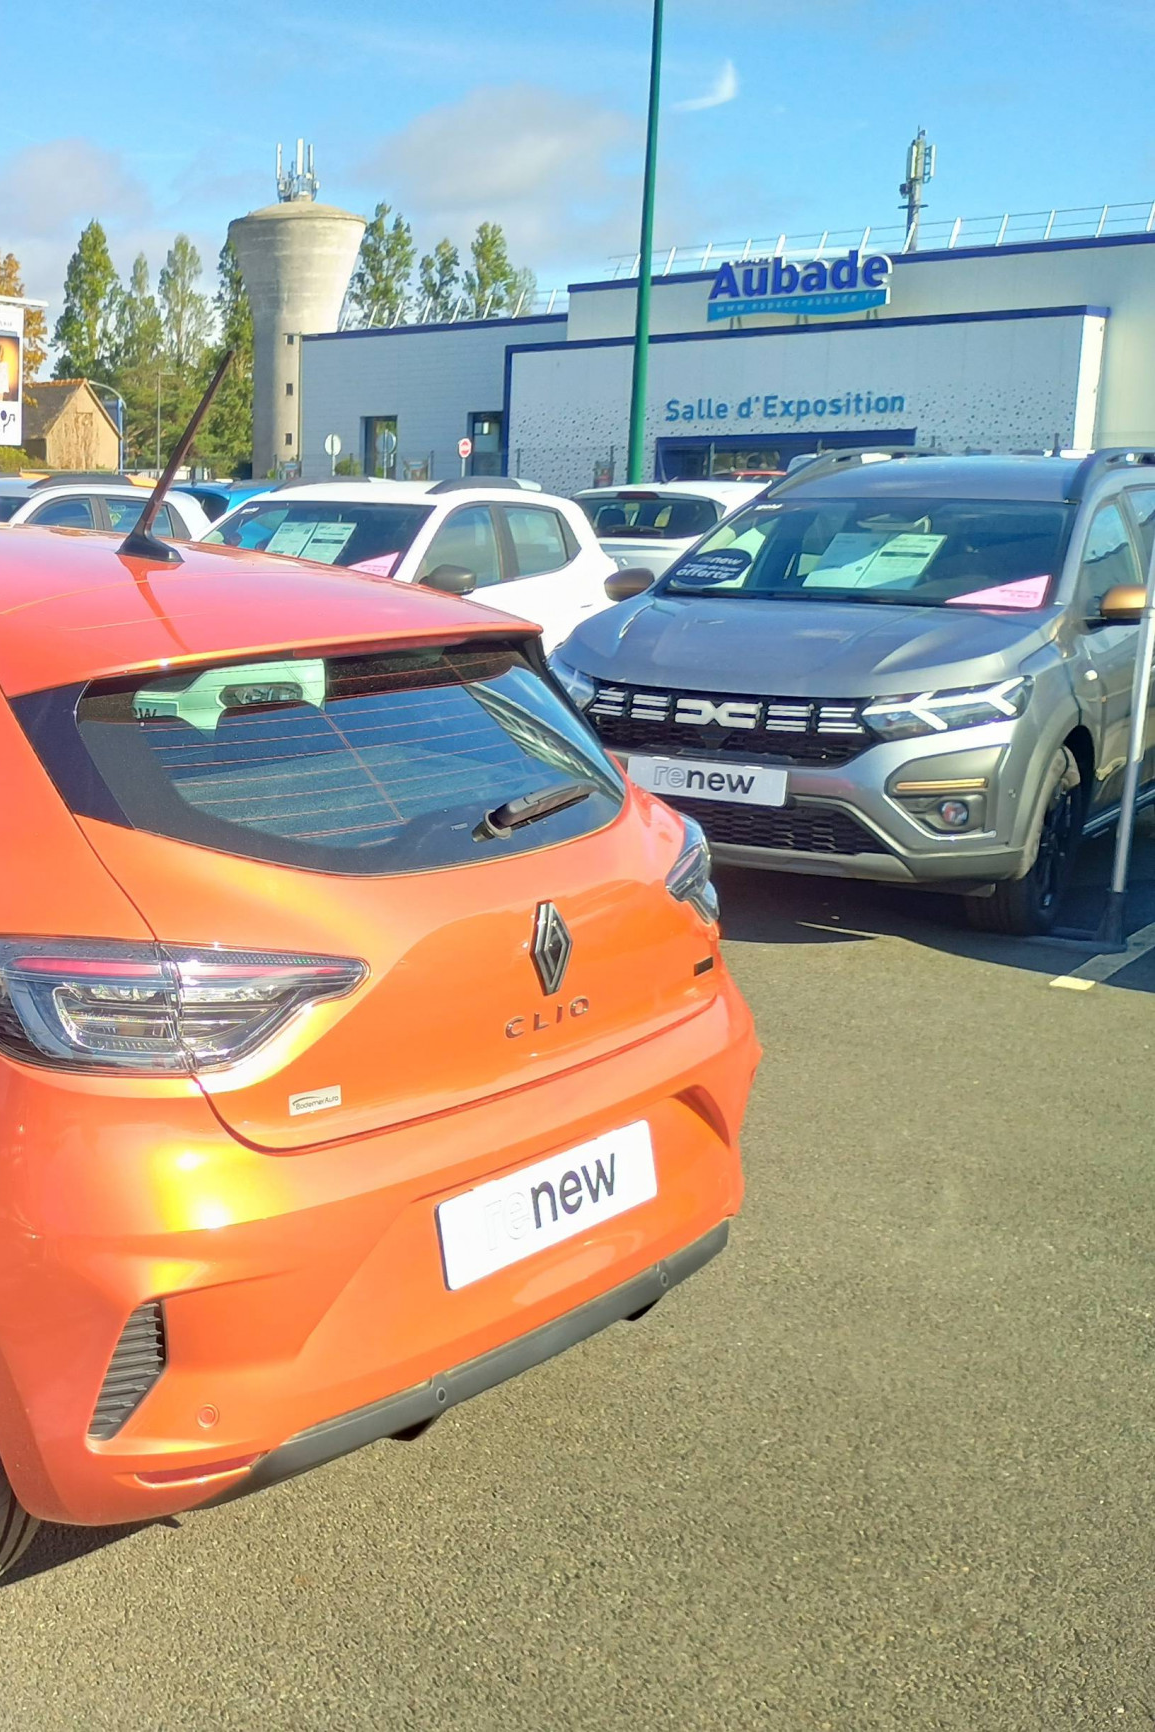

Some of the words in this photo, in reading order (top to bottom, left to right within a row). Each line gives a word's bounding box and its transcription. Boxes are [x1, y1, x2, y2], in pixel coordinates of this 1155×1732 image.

[709, 250, 890, 299] Aubade
[665, 398, 729, 422] Salle
[737, 391, 906, 422] d'Exposition
[653, 765, 756, 795] renew
[505, 995, 590, 1039] CLIO
[482, 1152, 615, 1251] renew
